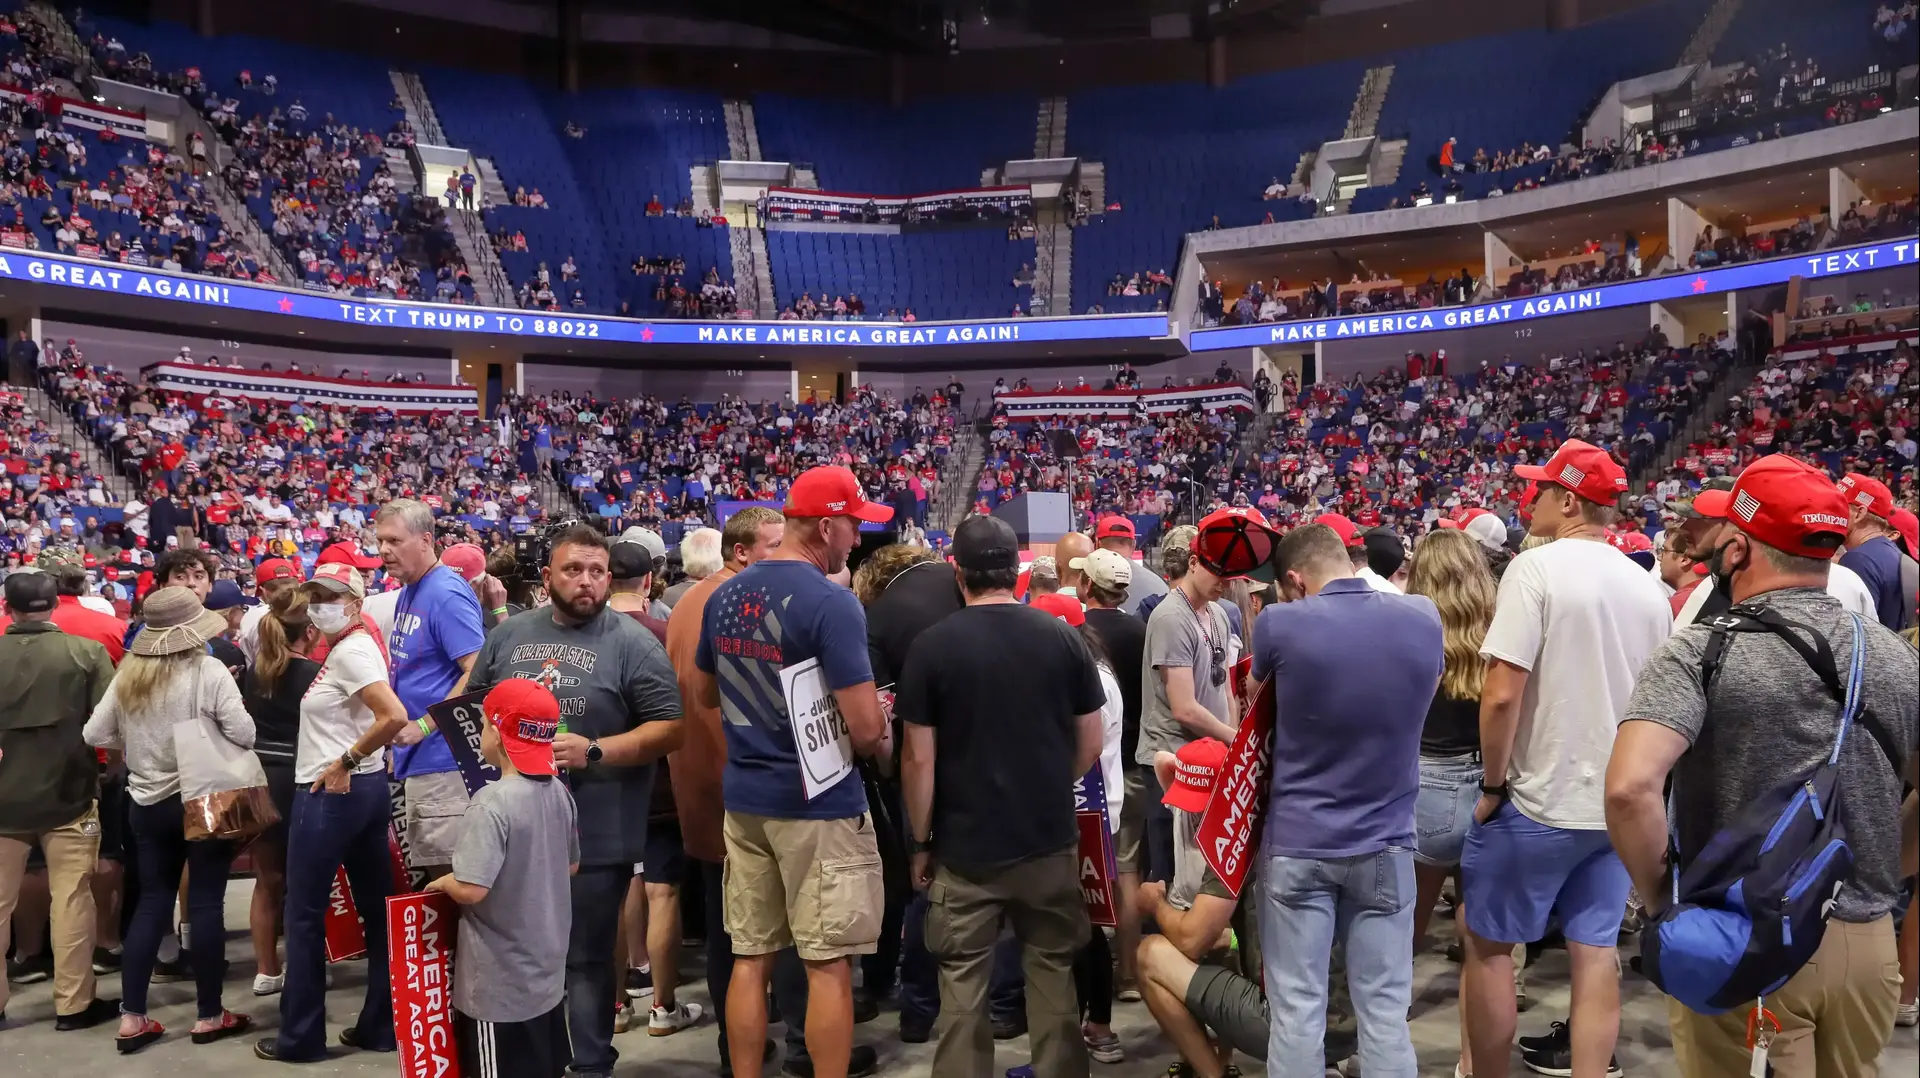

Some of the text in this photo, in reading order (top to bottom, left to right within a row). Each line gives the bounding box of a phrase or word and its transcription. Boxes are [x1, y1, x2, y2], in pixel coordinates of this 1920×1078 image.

[1808, 249, 1879, 275] TEXT
[28, 261, 123, 289] GREAT
[136, 276, 230, 304] AGAIN!
[340, 303, 599, 338] TEXT TRUMP TO 88022
[1271, 291, 1602, 342] MAKE AMERICA GREAT AGAIN!
[220, 340, 240, 350] 115
[698, 326, 1019, 344] MAKE AMERICA GREAT AGAIN!
[1514, 328, 1532, 339] 112
[727, 369, 743, 377] 114
[826, 500, 847, 508] TRUMP
[510, 643, 598, 674] OKLAHOMA STATE
[714, 636, 783, 663] FREEDOM
[805, 709, 850, 753] RANS
[1182, 763, 1215, 777] AMERICA
[1222, 729, 1261, 801] MAKE
[1186, 776, 1211, 787] AGAIN
[1214, 728, 1274, 864] AMERIC
[403, 905, 420, 993] GREAT
[421, 903, 450, 1078] AMERICA
